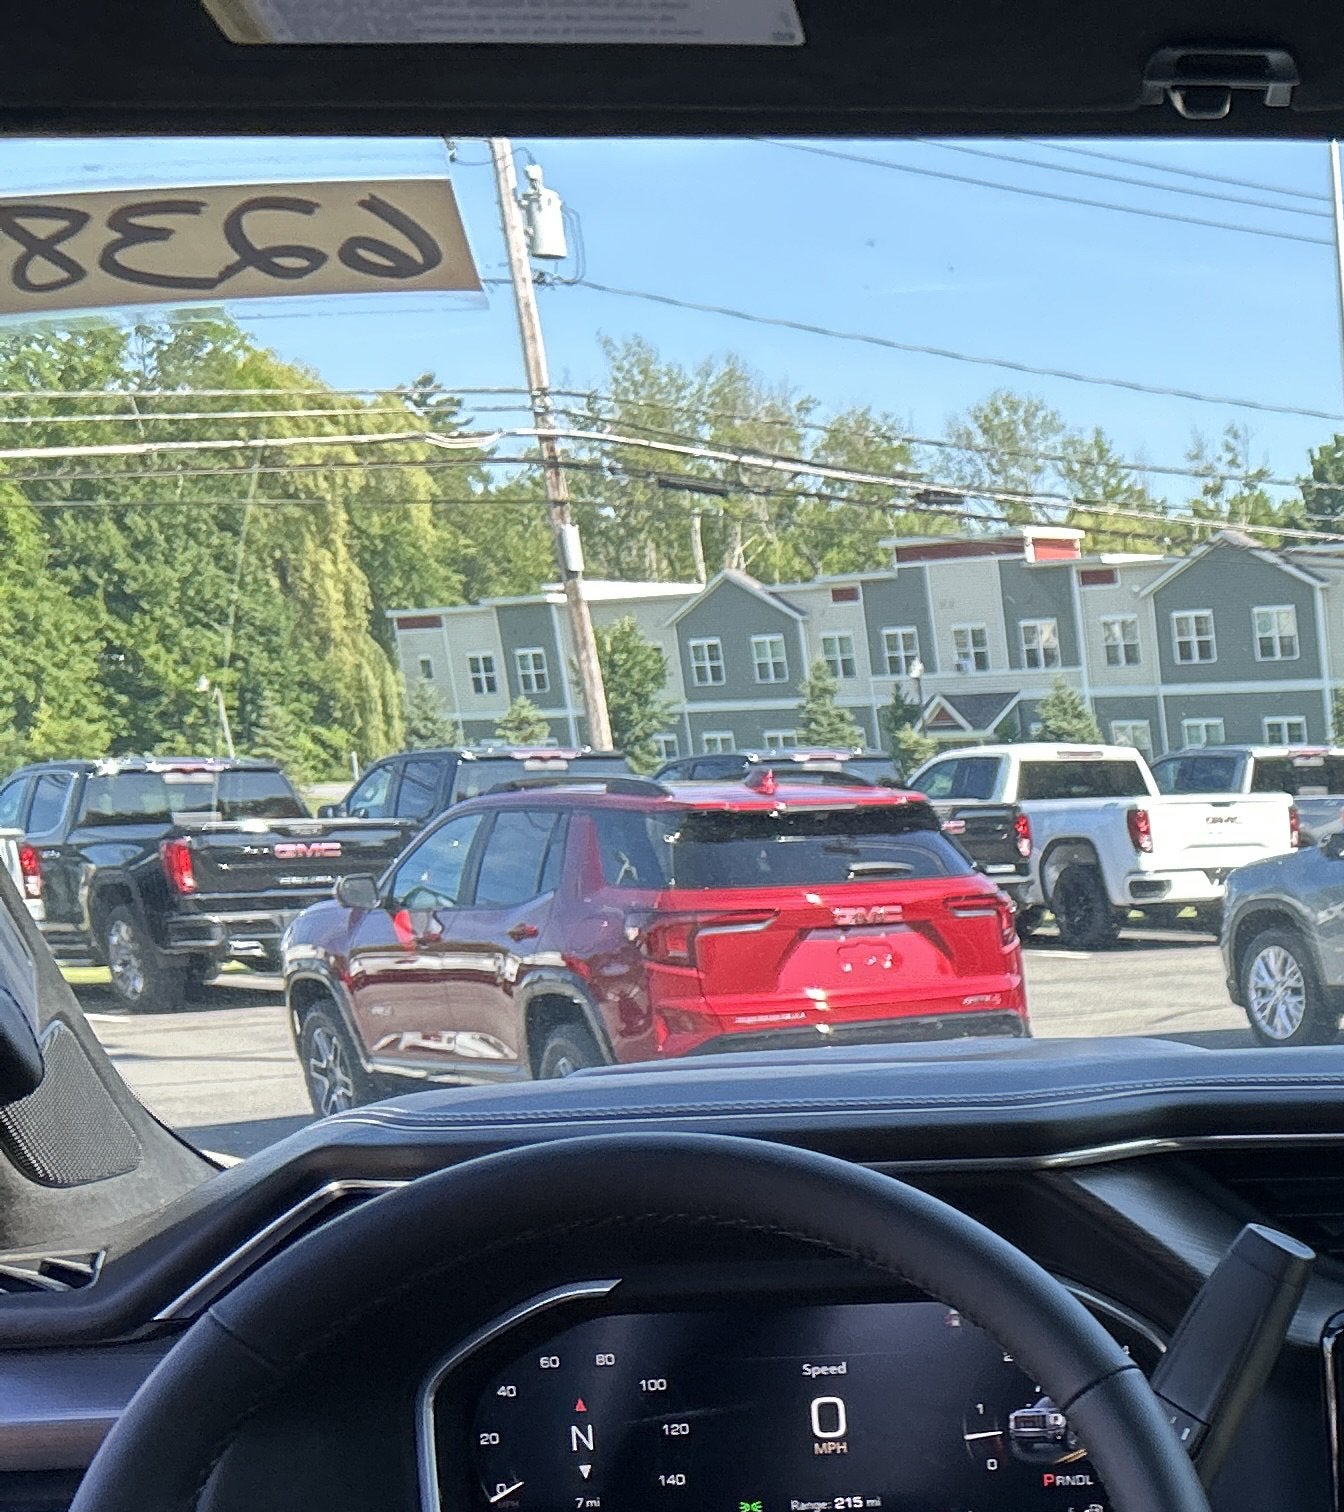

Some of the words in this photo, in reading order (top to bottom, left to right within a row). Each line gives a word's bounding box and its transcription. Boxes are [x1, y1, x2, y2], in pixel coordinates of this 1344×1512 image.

[274, 842, 342, 859] GMC
[831, 904, 904, 926] GMC
[539, 1355, 561, 1369] 60
[595, 1353, 617, 1366] 80
[801, 1361, 848, 1379] Speed
[496, 1385, 517, 1398] 40
[639, 1378, 668, 1392] 100
[975, 1403, 985, 1415] 1
[810, 1396, 848, 1438] 0
[661, 1423, 690, 1437] 120
[479, 1432, 500, 1445] 20
[571, 1424, 595, 1451] N
[814, 1441, 849, 1455] MPH
[987, 1458, 998, 1471] 0
[658, 1473, 687, 1487] 140
[586, 1497, 602, 1508] mi
[790, 1499, 833, 1512] Range:
[833, 1496, 864, 1510] 215
[866, 1495, 883, 1508] mi
